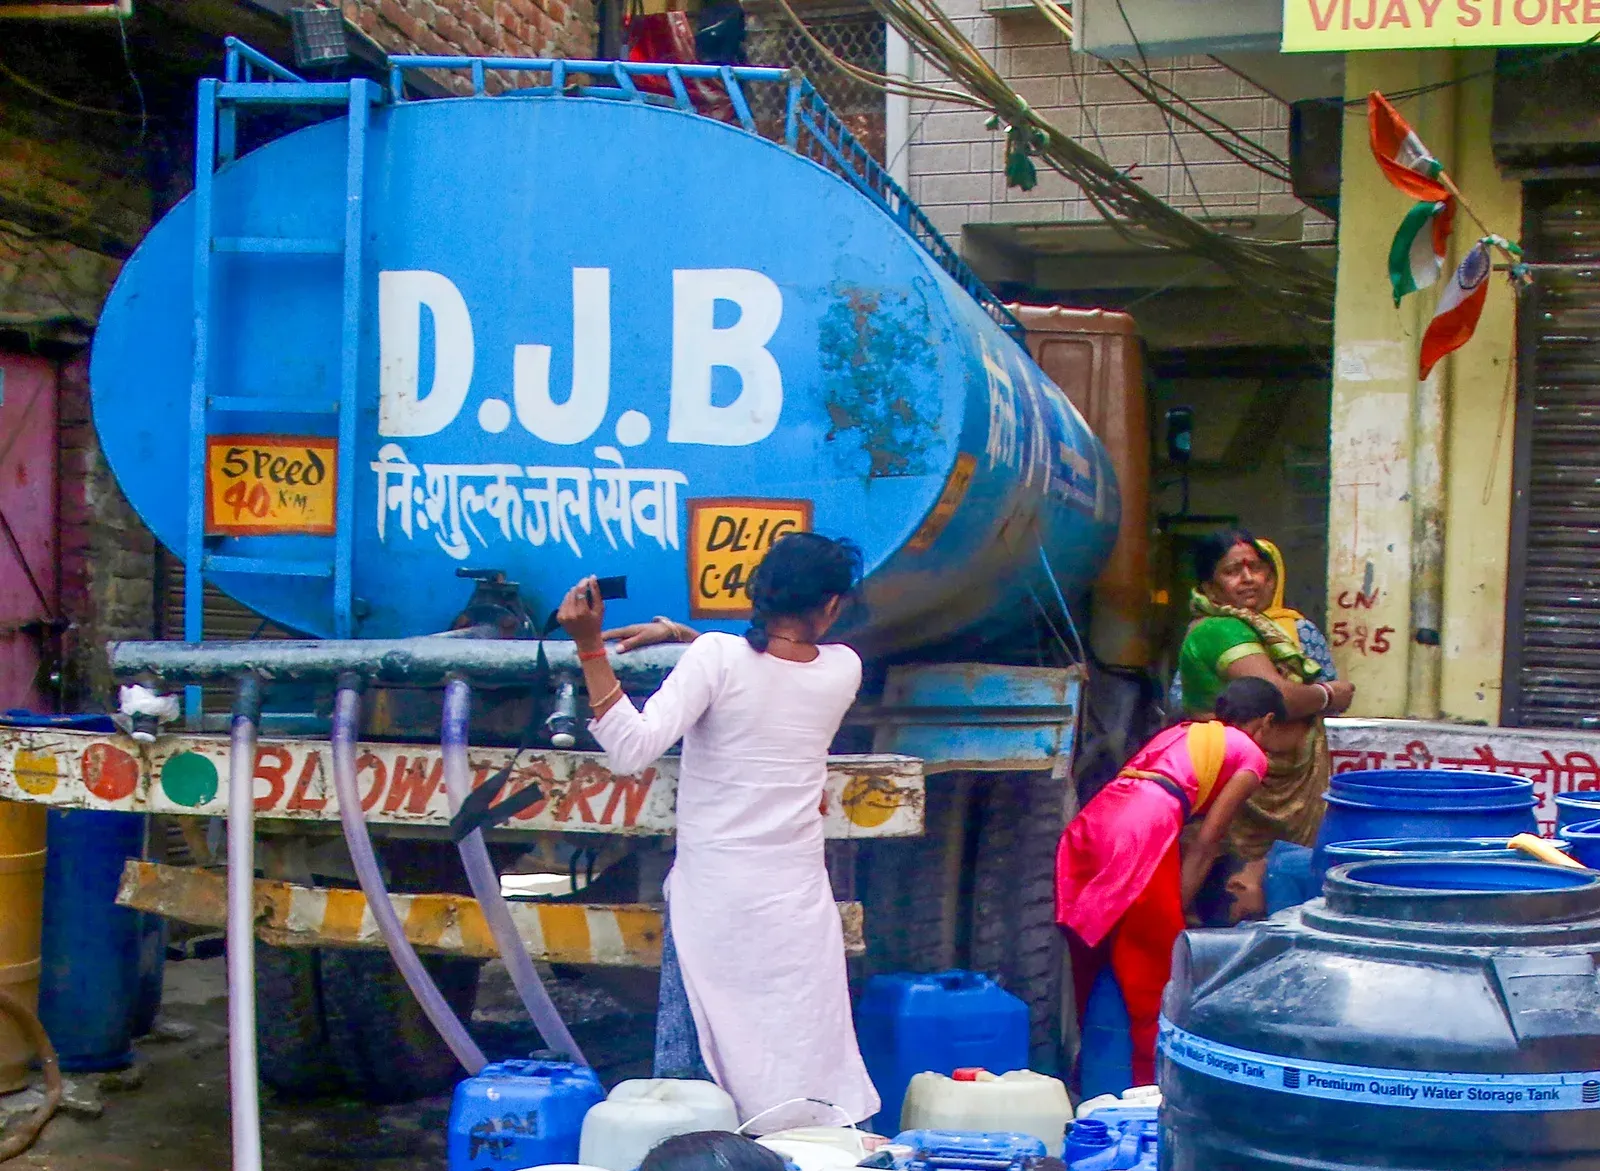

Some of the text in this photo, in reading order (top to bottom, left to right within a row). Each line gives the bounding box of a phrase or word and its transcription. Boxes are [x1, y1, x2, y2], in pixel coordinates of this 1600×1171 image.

[1305, 0, 1600, 31] VIJAY STORE
[522, 465, 593, 559] जल
[1206, 1053, 1240, 1074] Storage
[1240, 1062, 1266, 1079] Tank
[1307, 1073, 1561, 1104] Premium Quality Water Storage Tank
